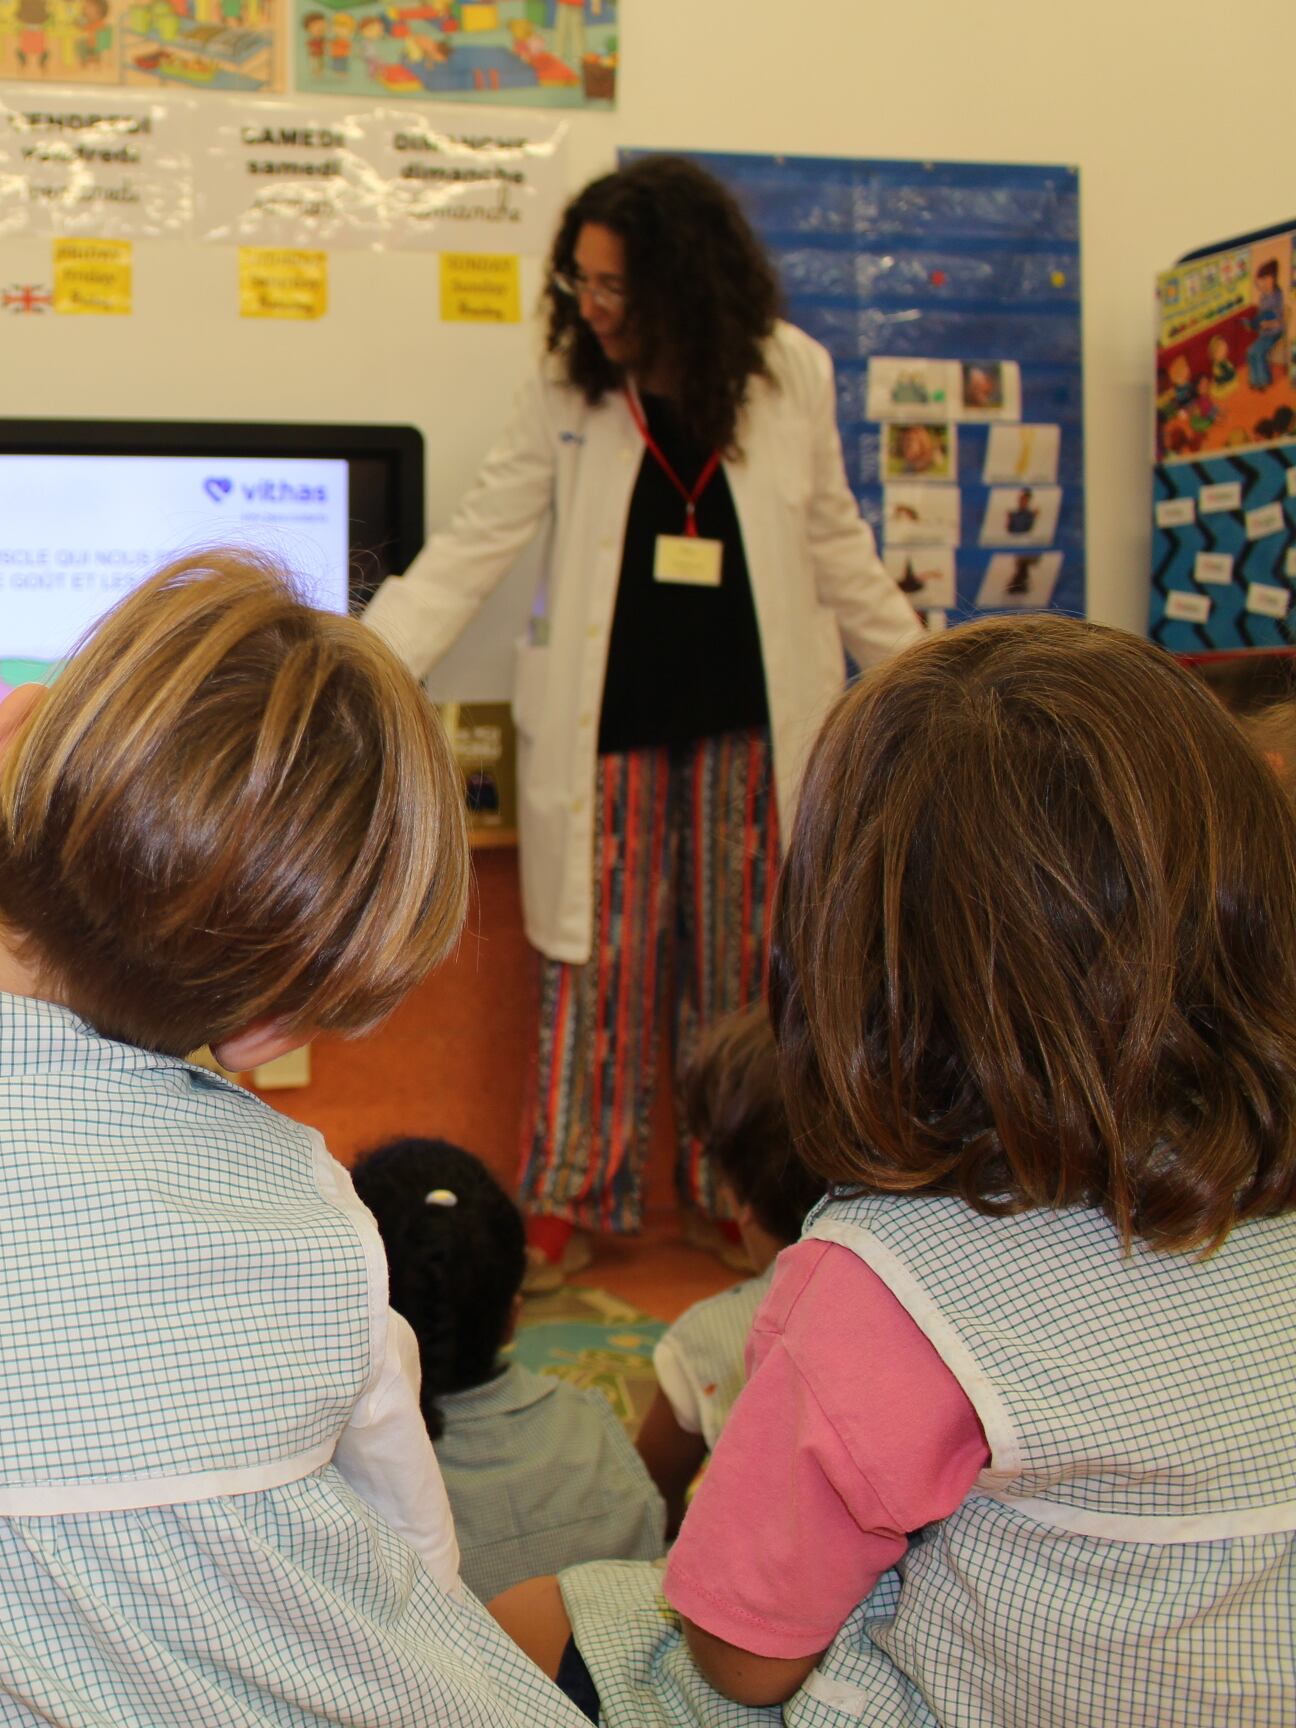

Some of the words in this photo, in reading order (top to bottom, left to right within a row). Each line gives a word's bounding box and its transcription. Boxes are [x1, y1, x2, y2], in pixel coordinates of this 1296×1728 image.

[247, 159, 341, 176] samedi
[401, 162, 524, 184] dimanche
[242, 478, 328, 502] vithas
